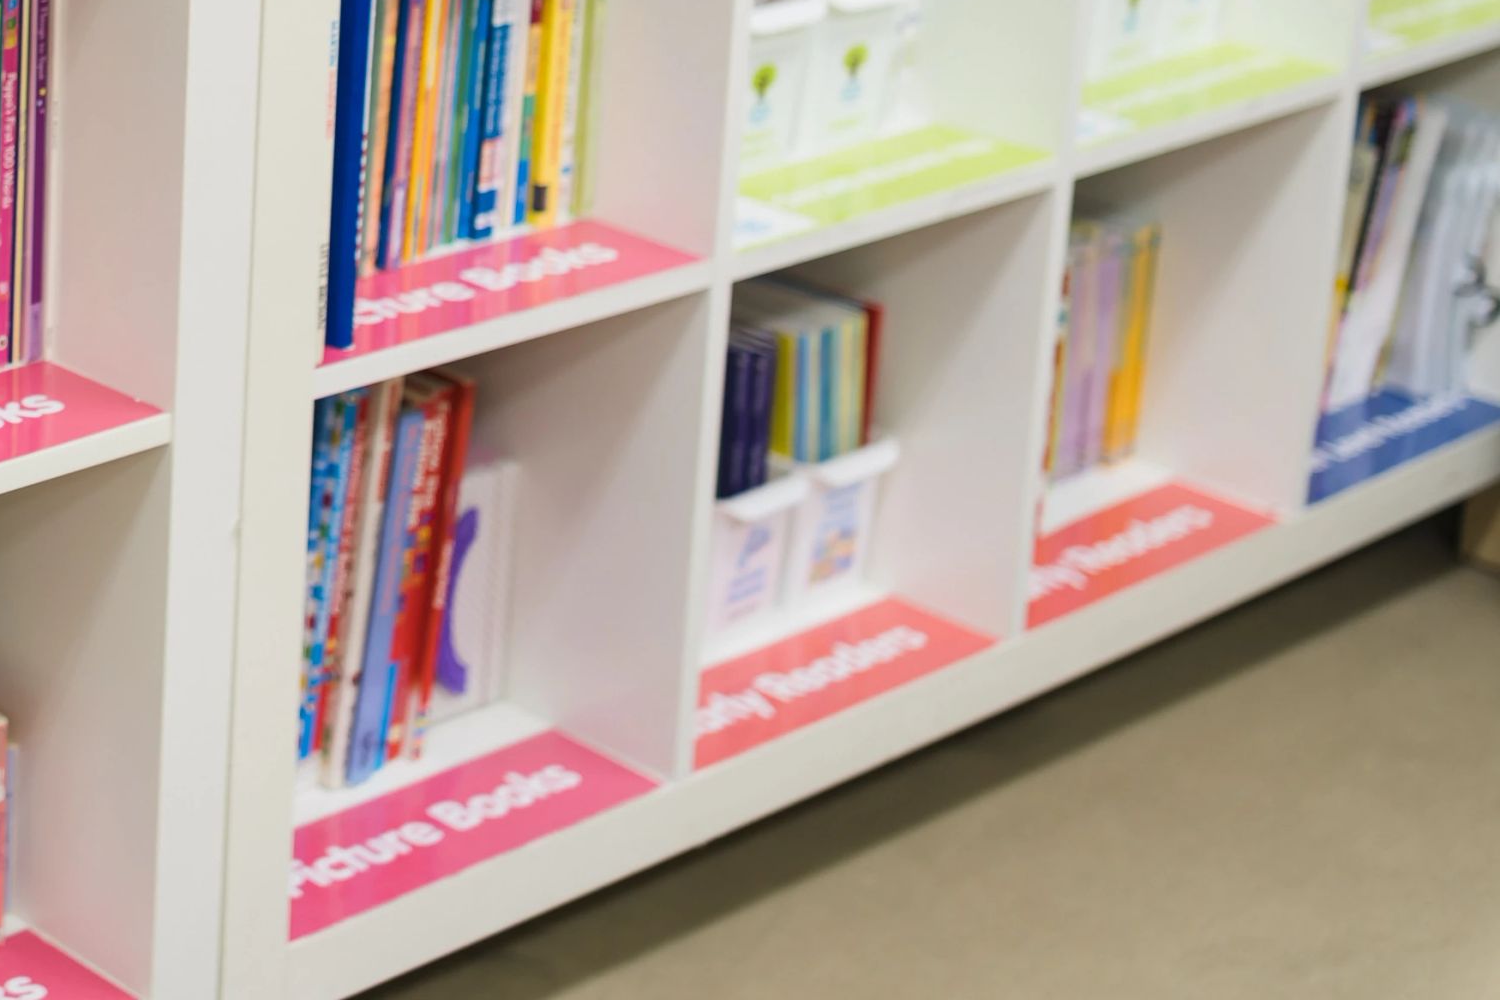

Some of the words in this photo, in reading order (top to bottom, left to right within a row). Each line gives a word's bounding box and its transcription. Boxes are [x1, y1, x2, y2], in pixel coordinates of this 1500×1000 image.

[3, 145, 15, 169] 100
[459, 242, 618, 292] Books
[426, 764, 583, 832] Books
